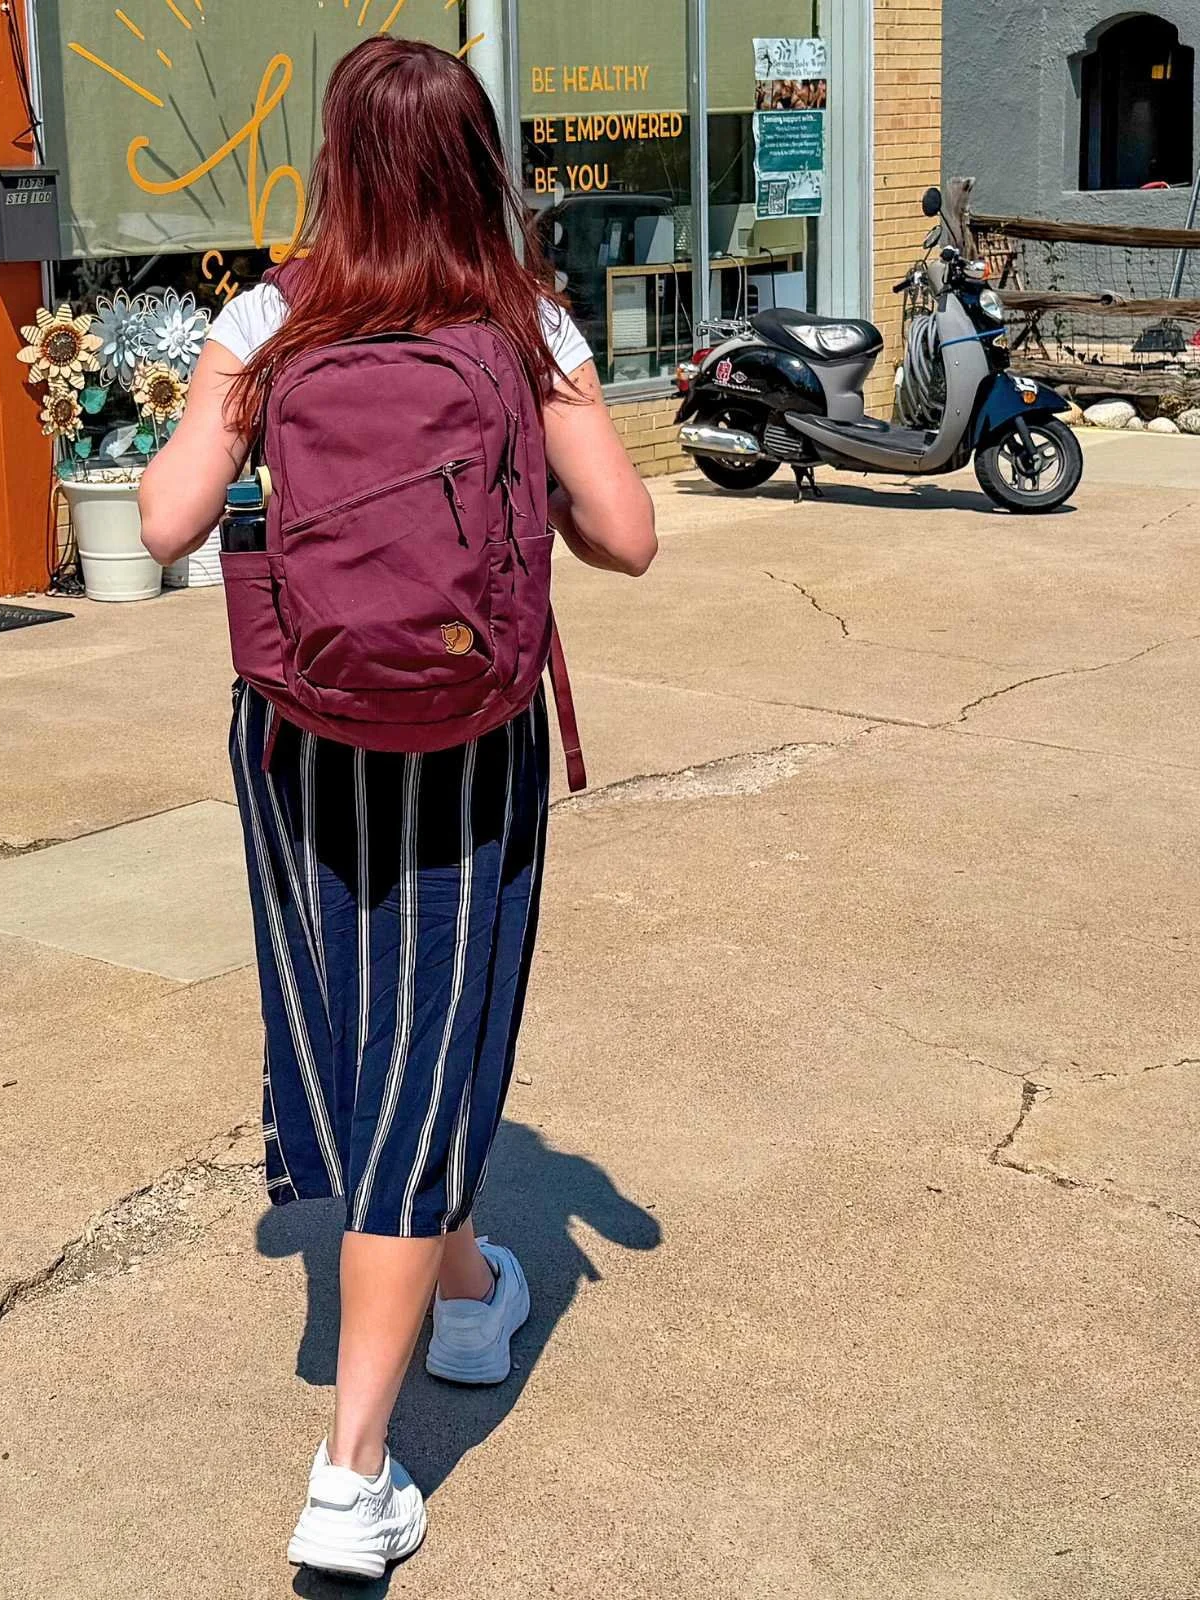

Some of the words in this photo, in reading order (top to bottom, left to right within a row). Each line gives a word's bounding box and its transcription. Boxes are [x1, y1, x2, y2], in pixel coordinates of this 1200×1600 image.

[531, 66, 556, 93] BE
[563, 64, 649, 93] HEALTHY
[533, 115, 558, 144] BE
[565, 112, 683, 142] EMPOWERED
[534, 167, 560, 193] BE
[566, 163, 609, 191] YOU
[7, 193, 27, 204] STE
[33, 192, 51, 202] 100
